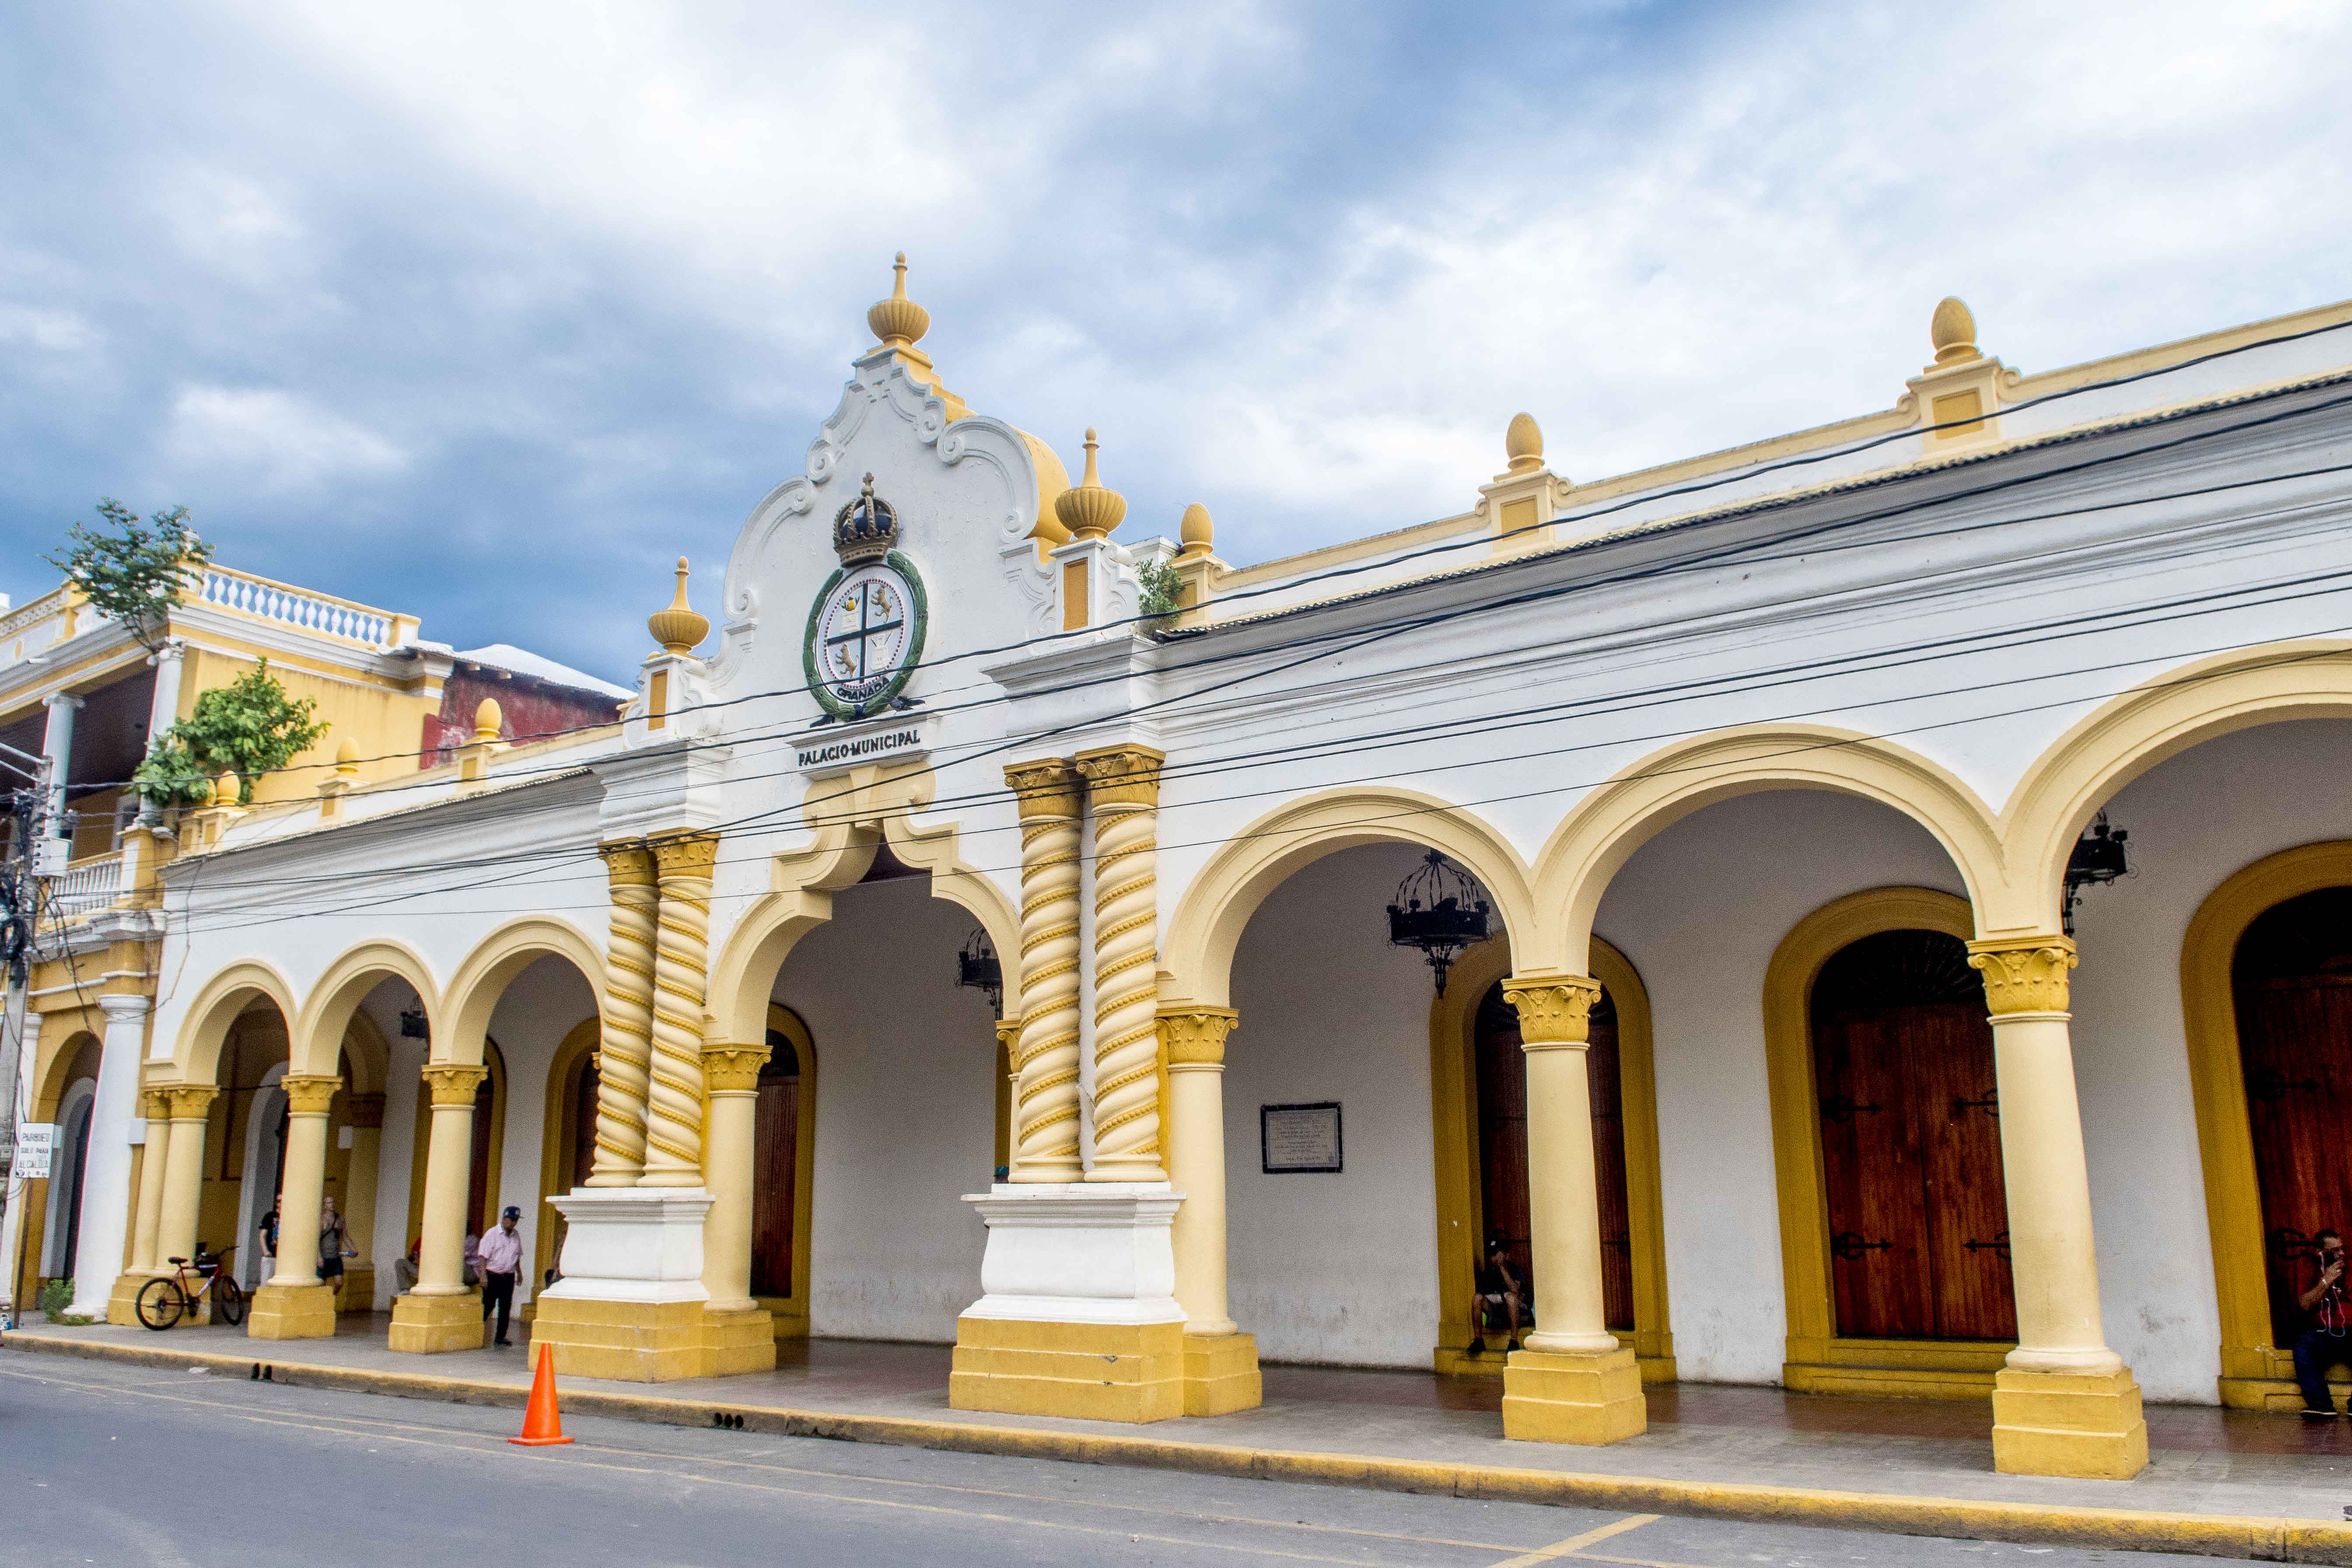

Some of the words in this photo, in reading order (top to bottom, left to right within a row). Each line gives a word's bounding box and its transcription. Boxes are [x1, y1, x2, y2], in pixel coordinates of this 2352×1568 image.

[837, 676, 890, 700] GRANADA
[799, 744, 849, 766] PALACIO
[851, 730, 920, 756] MUNICIPAL
